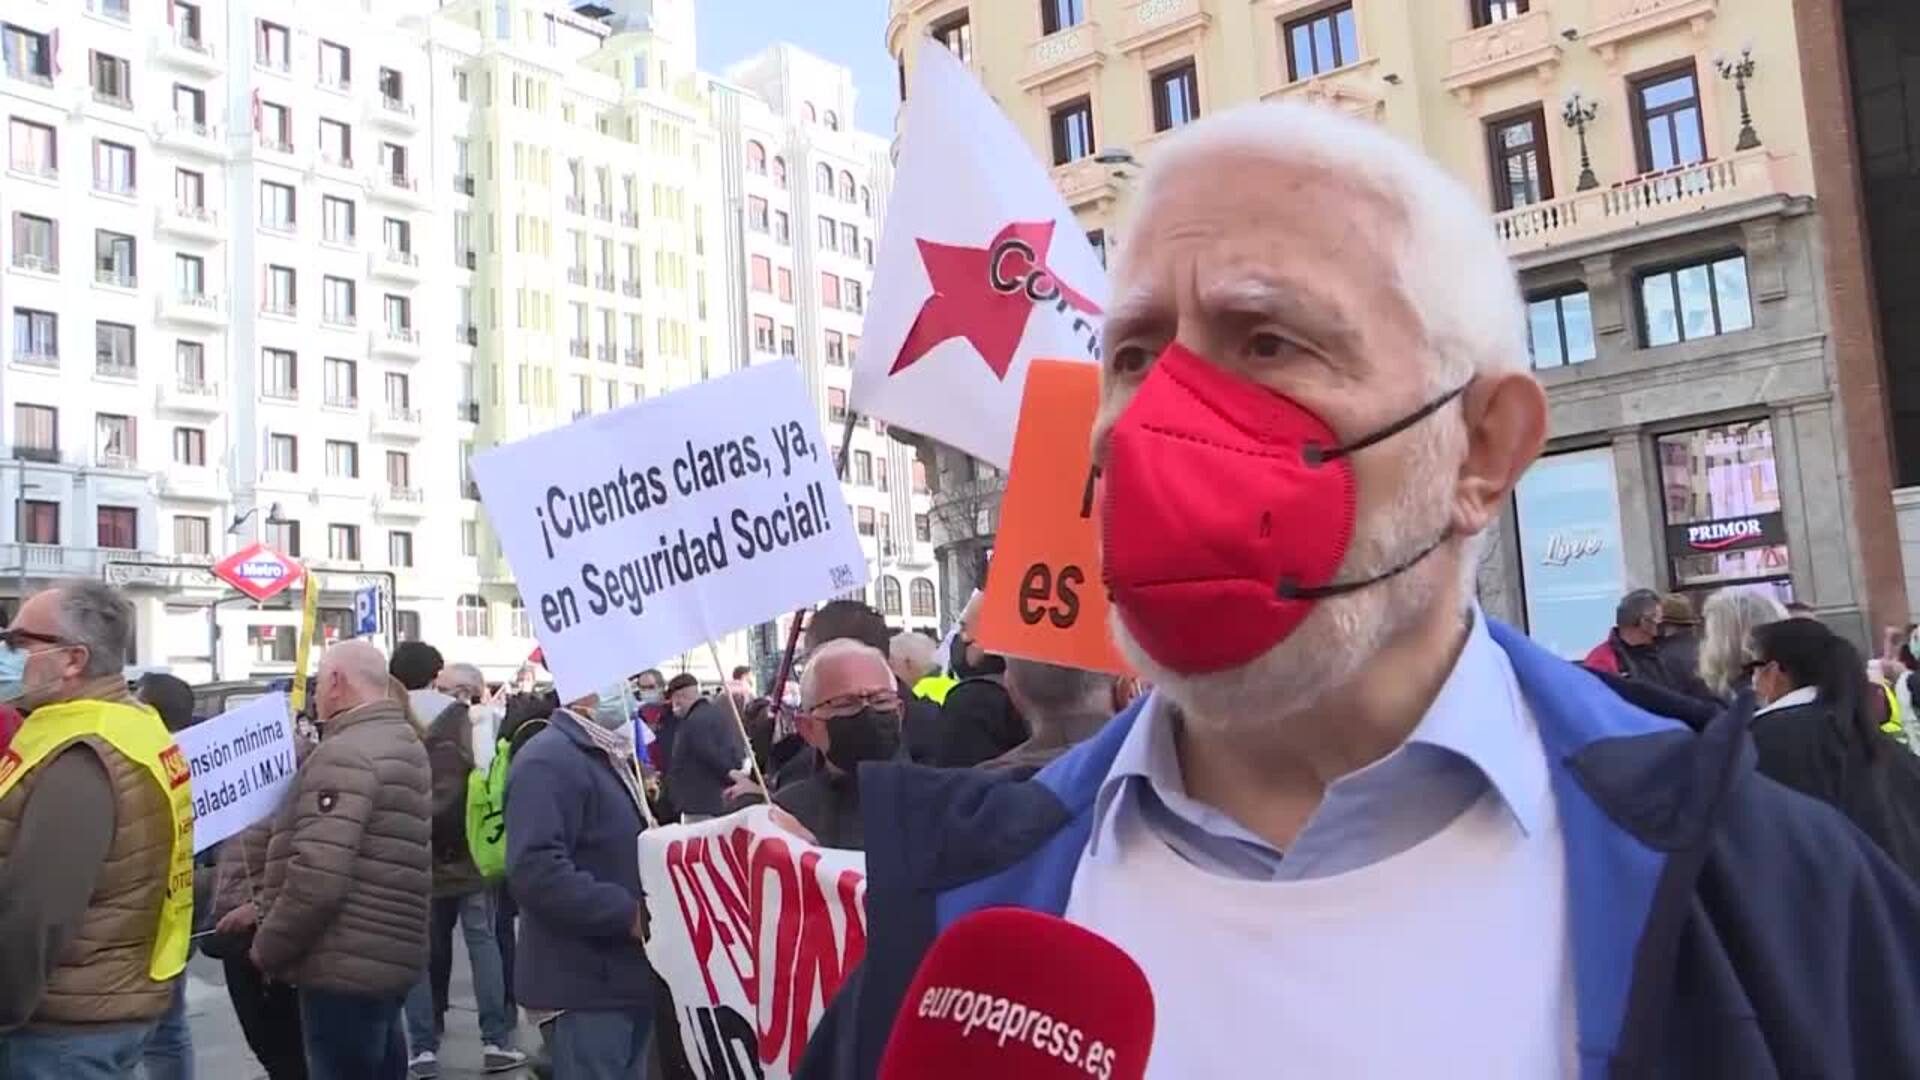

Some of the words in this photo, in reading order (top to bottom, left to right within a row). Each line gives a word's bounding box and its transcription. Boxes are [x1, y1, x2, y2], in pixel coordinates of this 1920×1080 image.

[536, 465, 667, 559] ¡Cuentas
[672, 435, 772, 496] claras,
[772, 420, 818, 477] ya,
[1541, 534, 1604, 567] Love
[1688, 519, 1762, 542] PRIMOR
[243, 562, 282, 578] Metro
[541, 584, 580, 634] en
[581, 517, 728, 616] Seguridad
[731, 481, 831, 559] Social!
[357, 592, 371, 633] P
[1018, 562, 1085, 629] es
[191, 740, 232, 777] nsión
[233, 720, 284, 758] mínima
[239, 769, 251, 797] al
[918, 986, 1115, 1080] europapress.es
